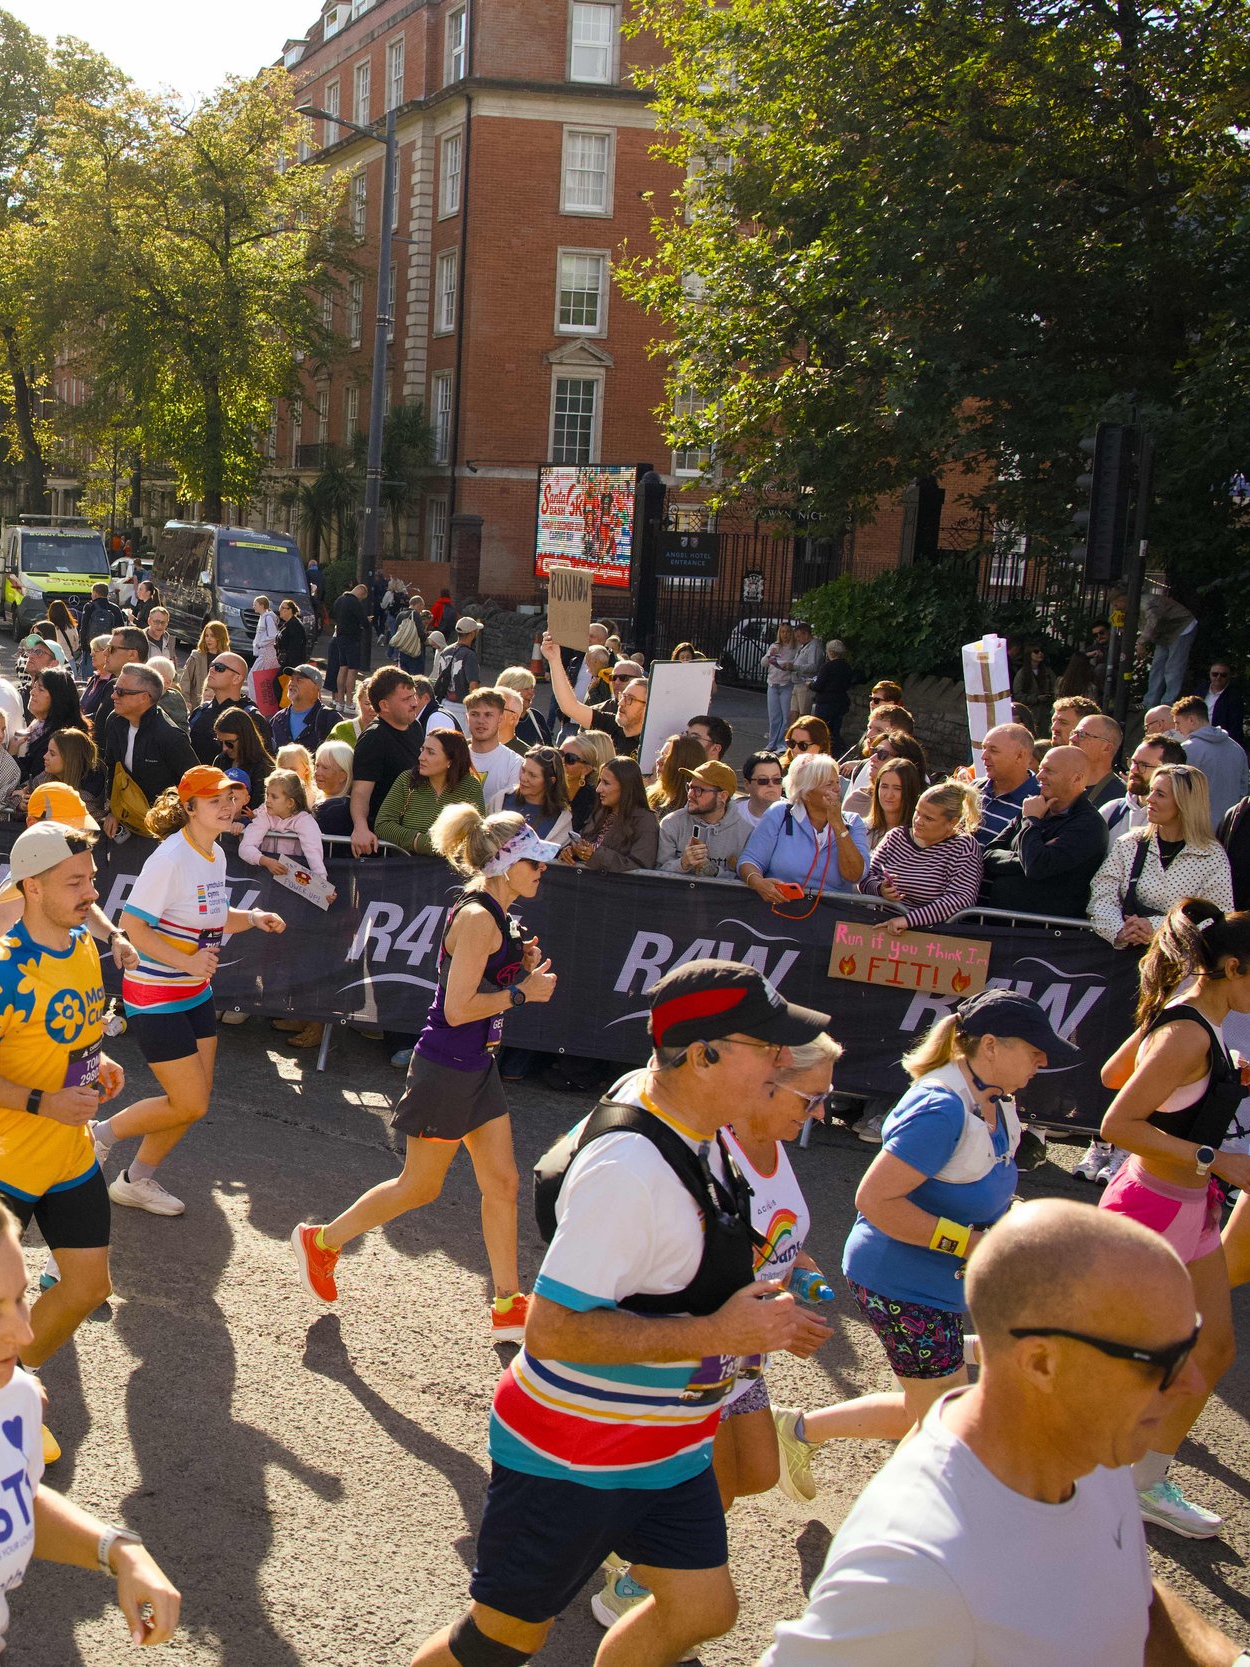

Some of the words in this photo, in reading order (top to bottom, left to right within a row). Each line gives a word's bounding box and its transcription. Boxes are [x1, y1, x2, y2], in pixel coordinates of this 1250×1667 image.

[670, 559, 706, 567] ENTRANCE
[688, 551, 711, 560] HOTEL
[835, 924, 864, 947] Run
[870, 932, 885, 949] if
[888, 940, 918, 961] you
[926, 941, 963, 962] think
[867, 956, 940, 989] FIT!
[899, 976, 1107, 1038] RW
